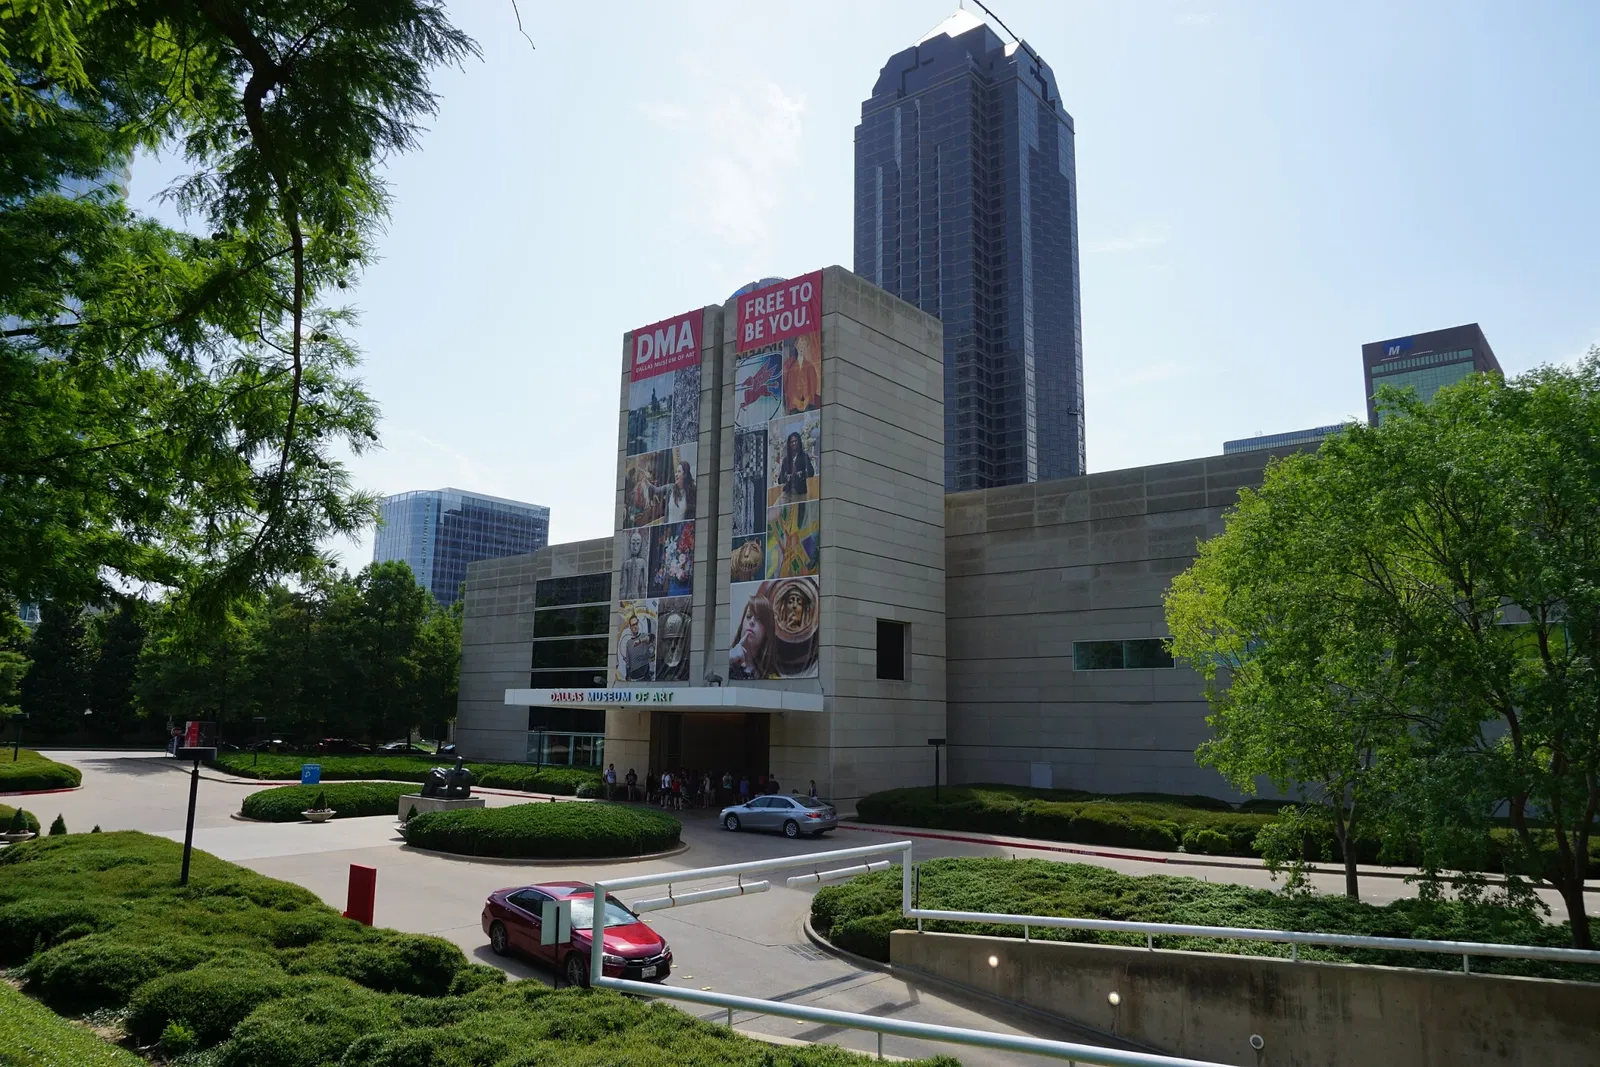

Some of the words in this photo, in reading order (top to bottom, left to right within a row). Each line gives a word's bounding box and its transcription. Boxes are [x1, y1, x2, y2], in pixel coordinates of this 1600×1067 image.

[745, 289, 785, 320] FREE
[789, 282, 813, 306] TO
[636, 320, 695, 365] DMA
[745, 319, 764, 343] BE
[769, 306, 810, 335] YOU.
[635, 363, 654, 374] DALLAS
[654, 356, 677, 368] MUSEUM
[677, 352, 685, 361] OF
[685, 351, 696, 359] ART
[551, 691, 584, 702] DALLAS
[587, 691, 632, 702] MUSEUM
[635, 691, 649, 702] OF
[652, 691, 674, 702] ART
